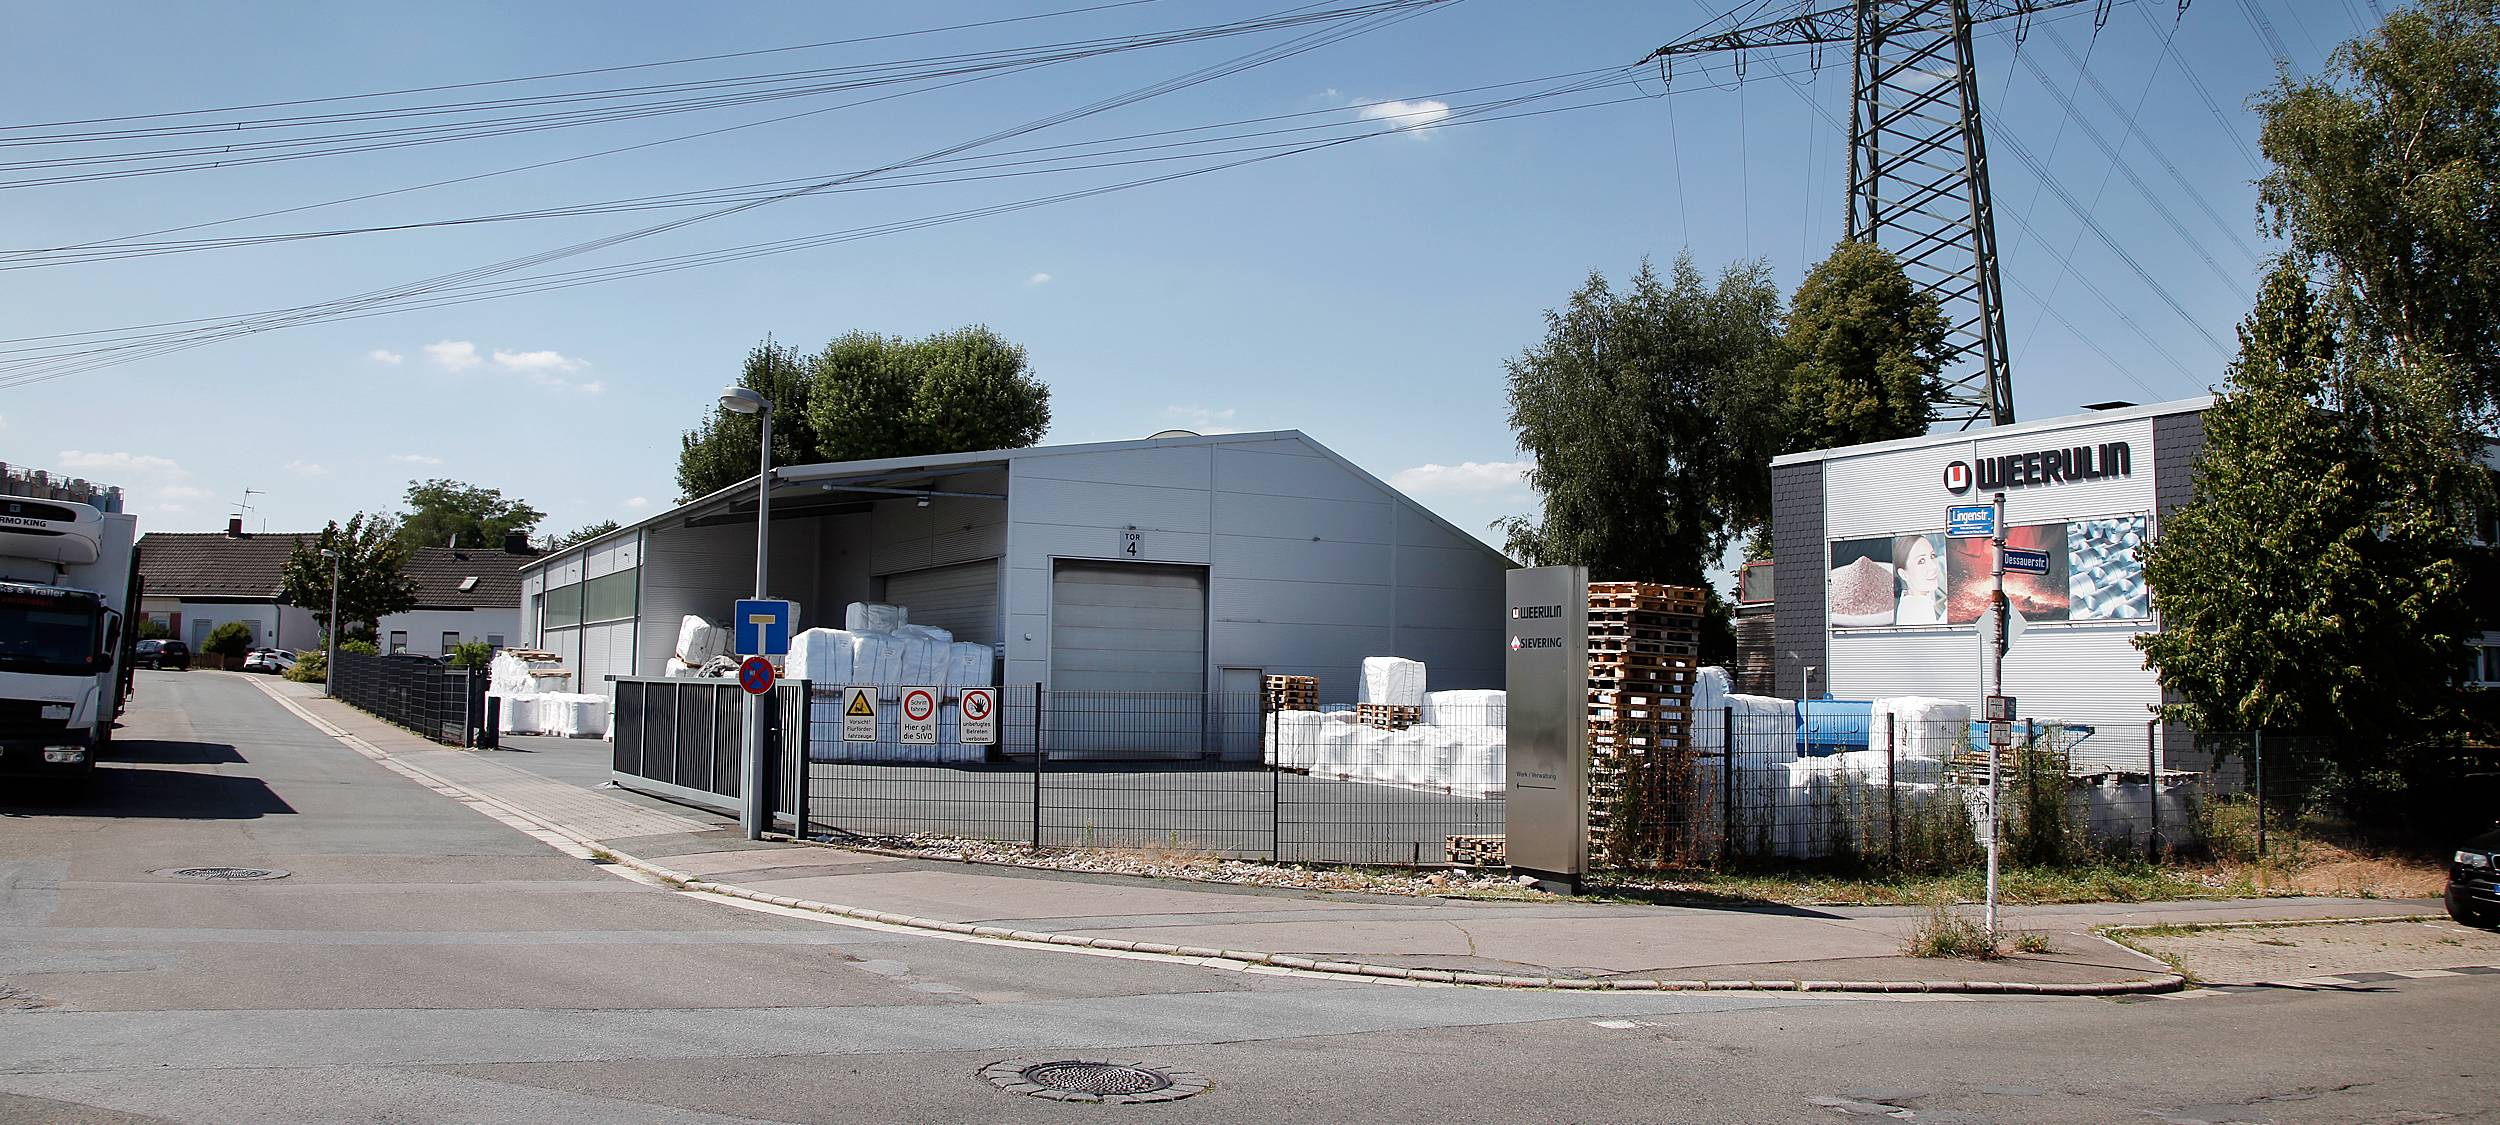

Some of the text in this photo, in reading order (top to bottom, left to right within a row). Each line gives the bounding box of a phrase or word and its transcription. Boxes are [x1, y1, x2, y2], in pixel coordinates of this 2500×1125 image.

[1976, 442, 2130, 488] WEERULIN
[1952, 509, 1991, 524] Lingenstr.
[23, 519, 47, 527] KING
[1125, 533, 1140, 541] TOR
[1126, 541, 1137, 557] 4
[31, 588, 65, 597] Trailer
[1520, 605, 1561, 619] WEERULIN
[1520, 637, 1562, 649] SIEVERING
[904, 723, 932, 733] Hier gilt
[903, 732, 914, 740] die
